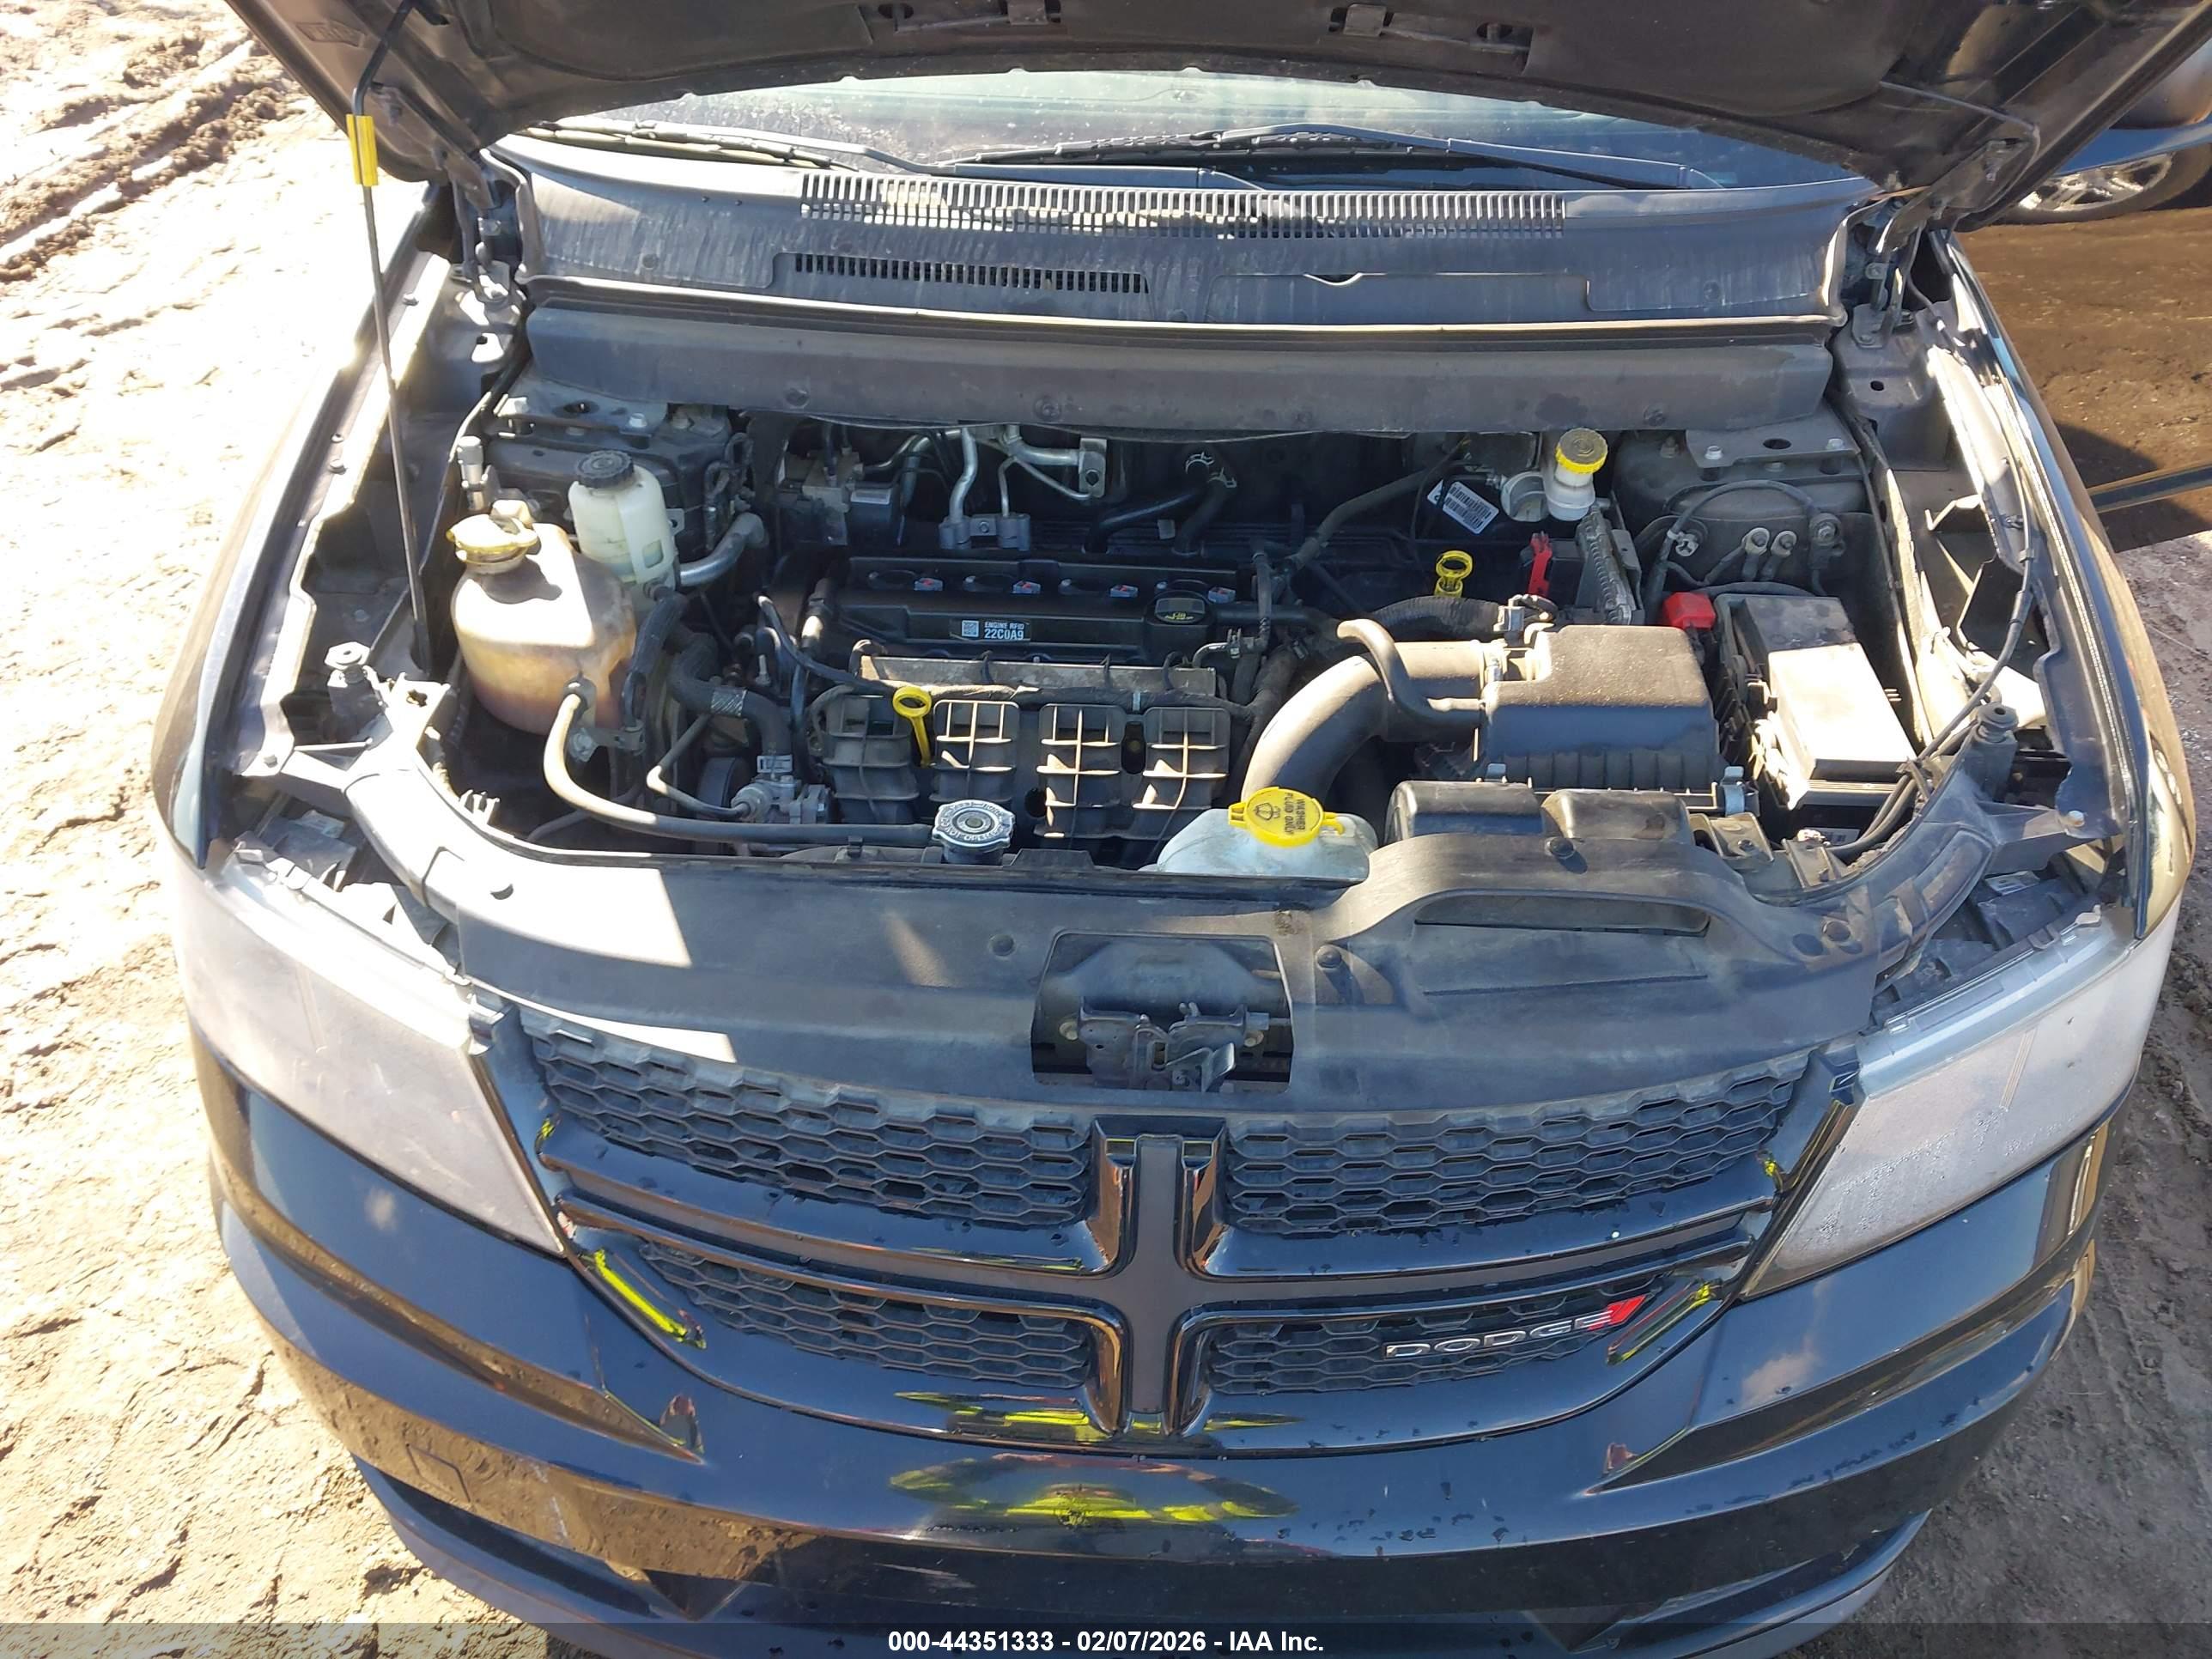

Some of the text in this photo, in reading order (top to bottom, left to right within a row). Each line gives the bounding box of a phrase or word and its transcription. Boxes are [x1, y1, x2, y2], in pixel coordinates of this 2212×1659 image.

[1284, 815, 1294, 835] ONLY
[1295, 799, 1306, 830] WASHER
[1385, 1310, 1613, 1358] DODGE
